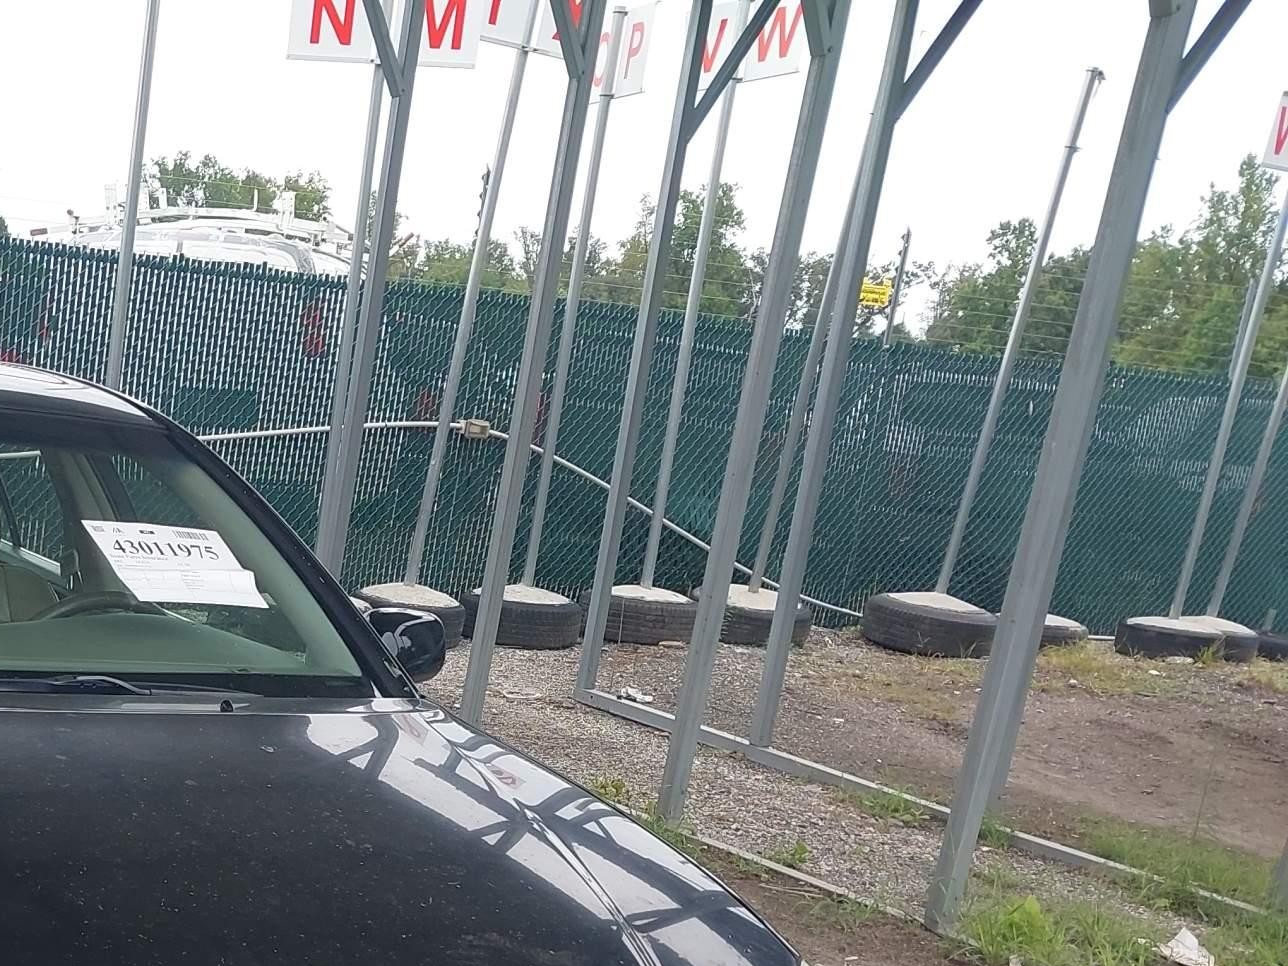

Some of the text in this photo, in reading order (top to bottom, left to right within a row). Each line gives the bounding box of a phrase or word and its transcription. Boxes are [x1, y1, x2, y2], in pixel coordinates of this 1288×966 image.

[309, 0, 356, 46] N
[758, 3, 804, 63] W
[623, 21, 644, 79] P
[112, 538, 220, 561] 43011975
